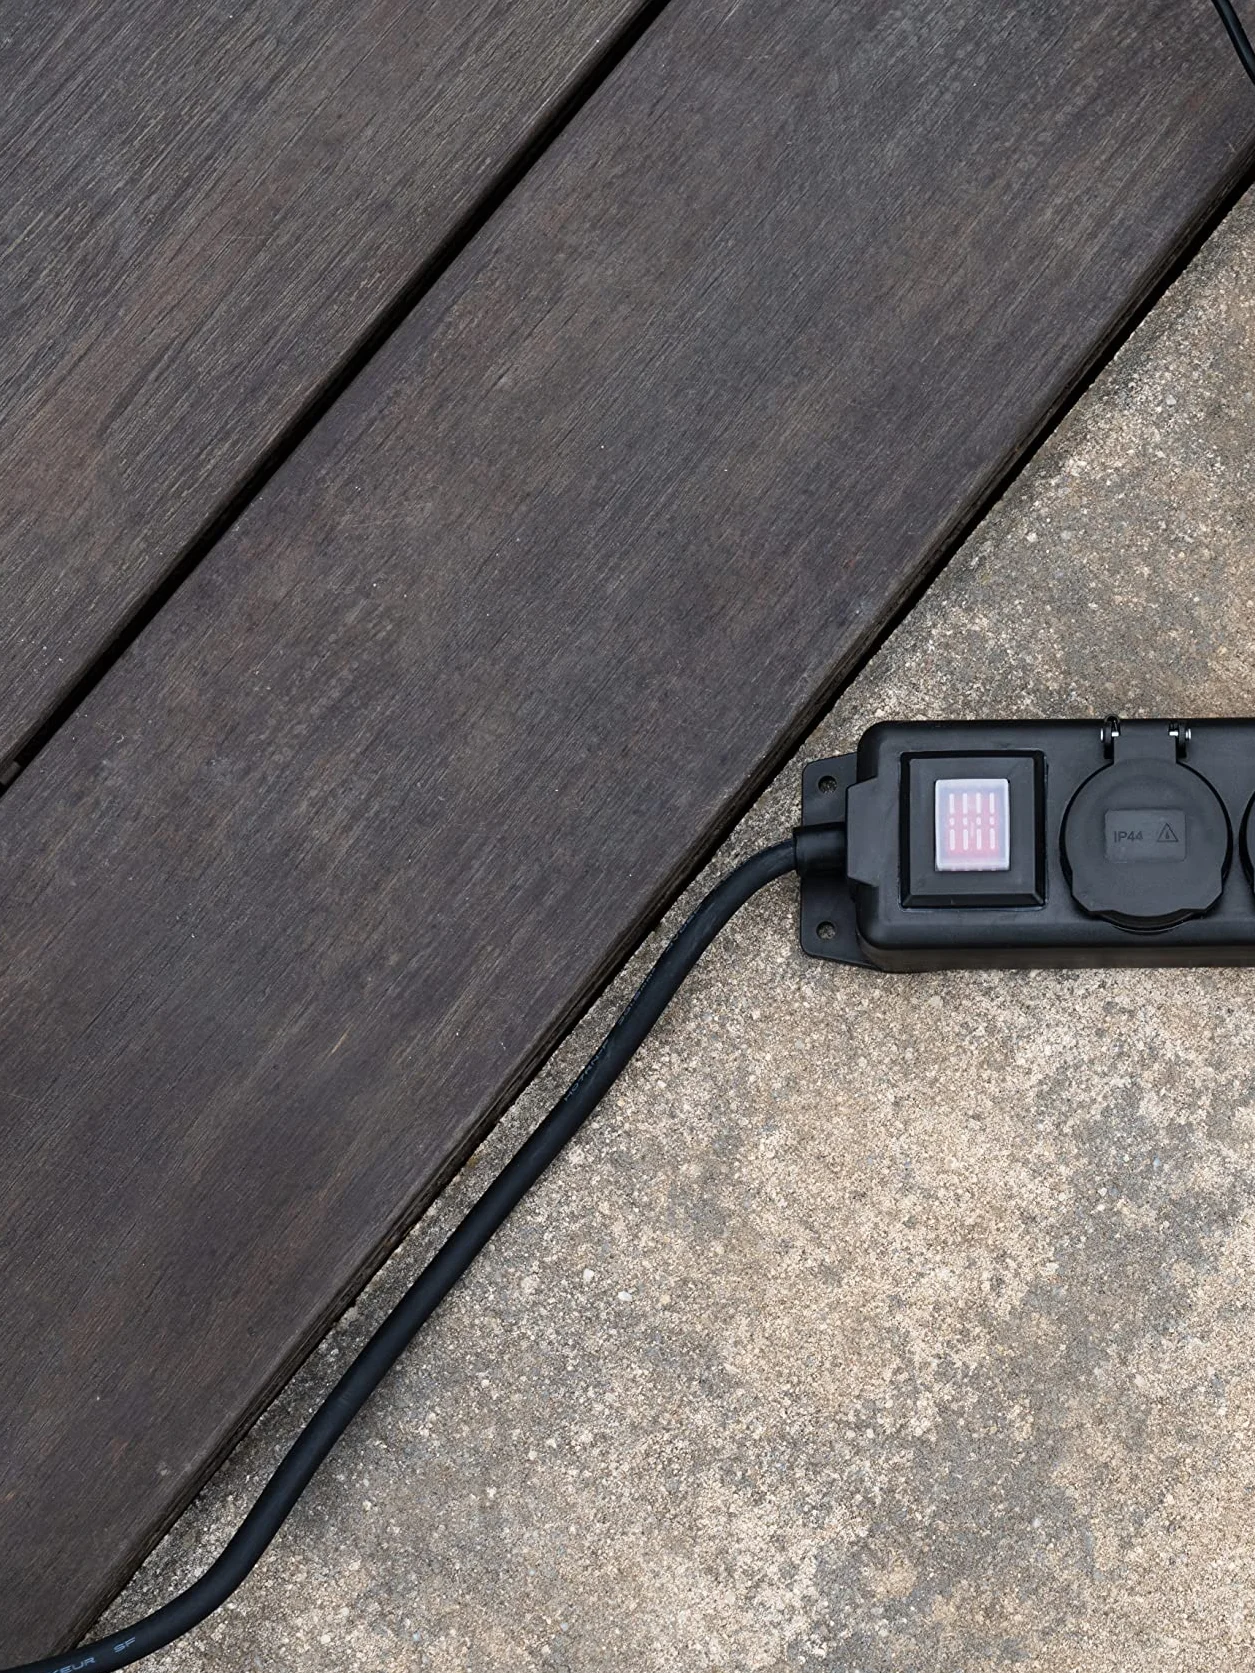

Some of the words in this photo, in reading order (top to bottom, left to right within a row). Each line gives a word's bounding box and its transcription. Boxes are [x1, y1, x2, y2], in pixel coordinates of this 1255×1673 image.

[1113, 830, 1144, 843] IP44
[50, 1656, 96, 1673] EUR
[113, 1636, 136, 1653] SF
